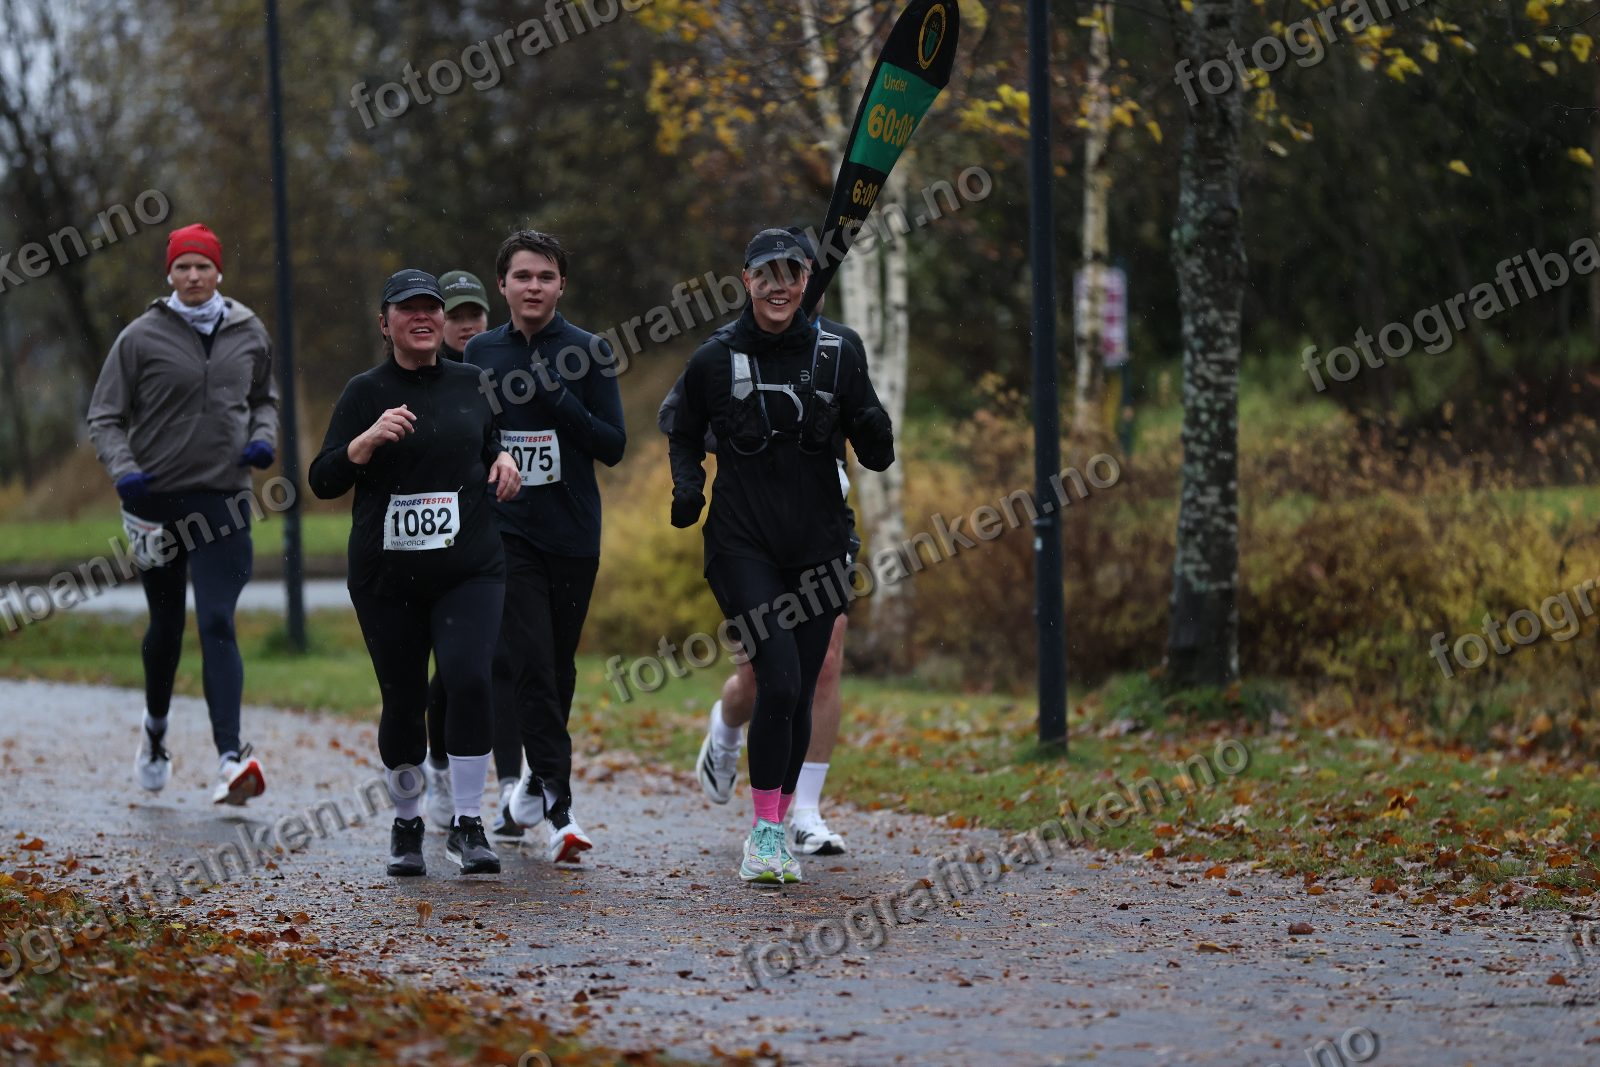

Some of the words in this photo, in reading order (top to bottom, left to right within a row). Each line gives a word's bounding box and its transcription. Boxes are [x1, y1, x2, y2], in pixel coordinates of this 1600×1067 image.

[884, 73, 908, 94] Under
[852, 178, 879, 208] 6:00
[391, 507, 453, 537] 1082
